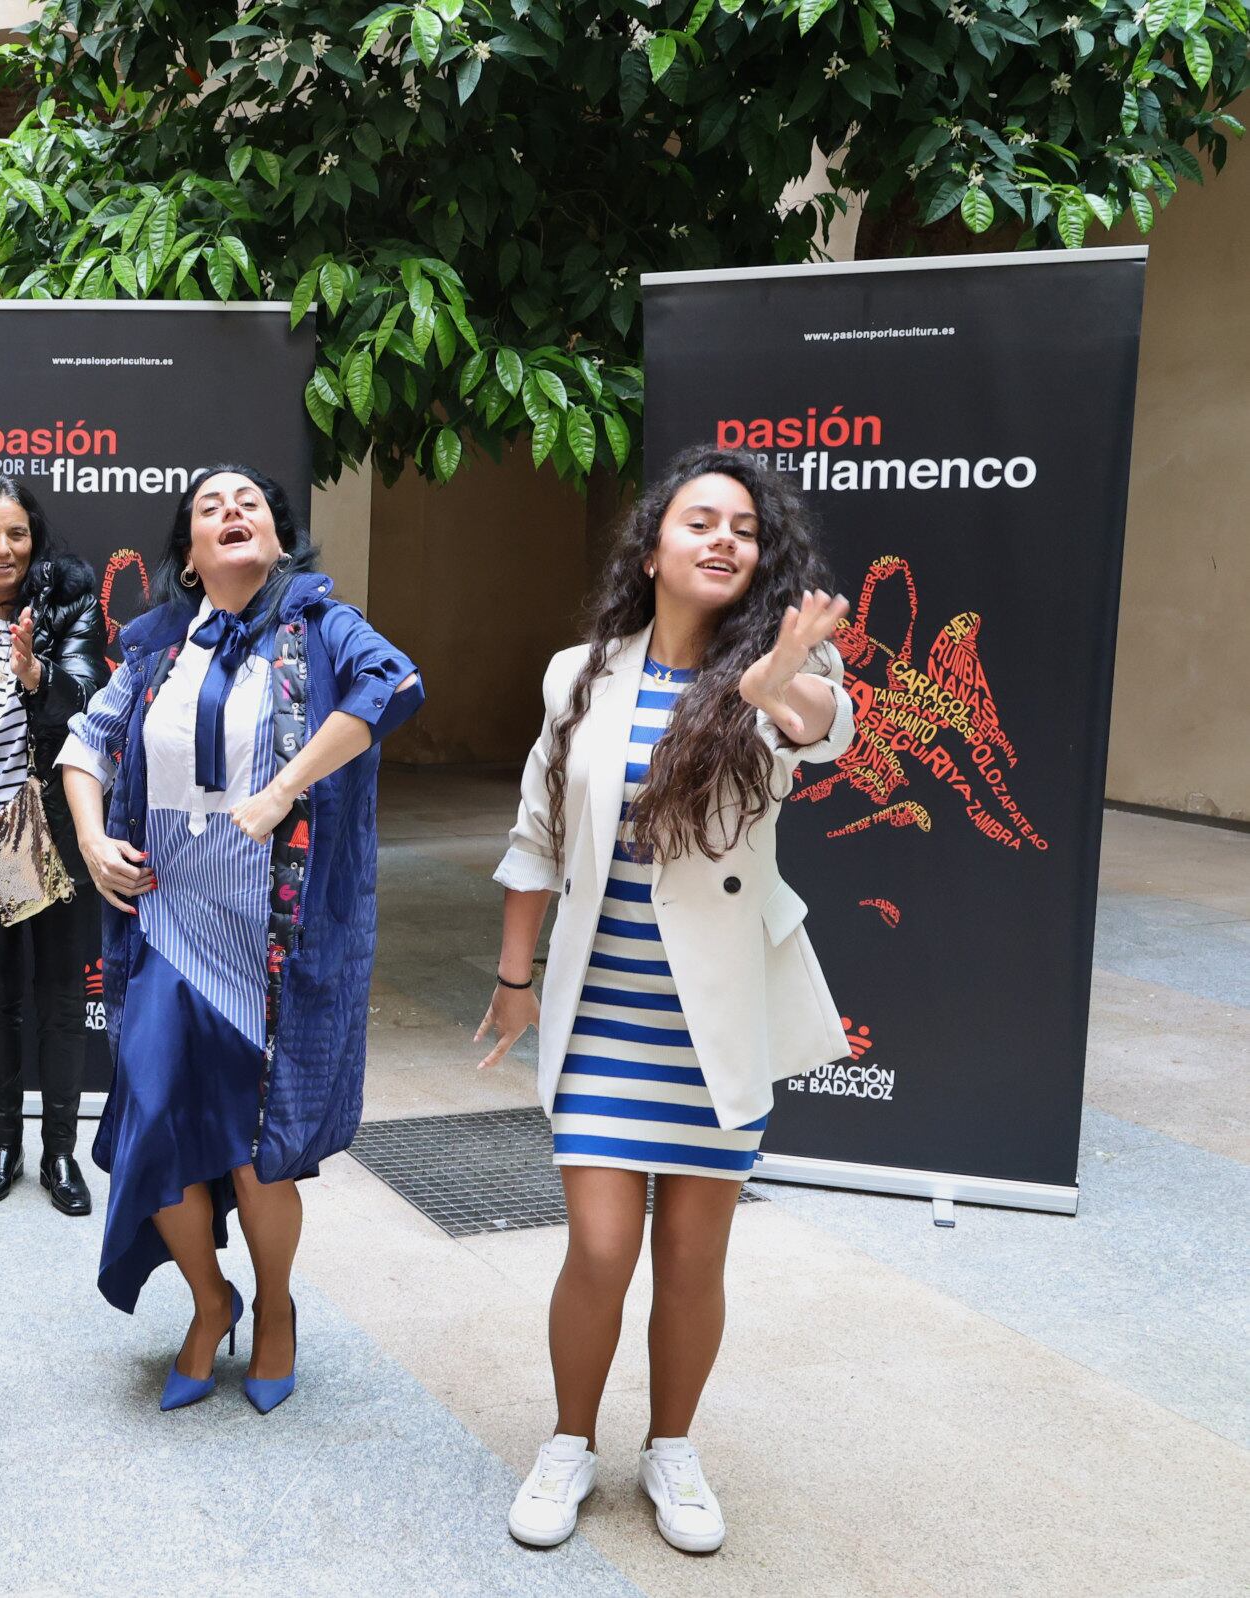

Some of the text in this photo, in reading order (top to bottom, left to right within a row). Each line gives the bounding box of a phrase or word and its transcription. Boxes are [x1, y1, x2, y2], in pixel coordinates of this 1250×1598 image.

[803, 327, 956, 341] www.pasionporlacultura.es
[52, 356, 174, 366] www.pasionporlacultura.es
[716, 405, 883, 452] pasión
[30, 458, 50, 475] EL
[50, 458, 210, 494] flamen
[776, 453, 799, 472] EL
[799, 451, 1037, 491] flamenco
[854, 565, 881, 635] BAMBERA
[943, 611, 980, 645] SAETA
[930, 629, 993, 701] RUMBA
[873, 687, 975, 739] TANGOS Y JALEOS
[891, 660, 971, 722] CARACOL
[927, 655, 1000, 727] NANAS
[859, 721, 905, 777] FANDANGO
[879, 706, 938, 744] TARANTO
[970, 711, 1018, 769] SERRANA
[864, 710, 972, 802] SEGUIRIYA
[965, 731, 1003, 785] POLO
[850, 766, 887, 797] ALBOLEA
[826, 825, 857, 838] CANTE
[965, 799, 1021, 850] ZAMBRA
[991, 782, 1049, 850] ZAPATEAO
[787, 1077, 894, 1101] DE BADAJOZ
[801, 1063, 896, 1086] UTACIÓN
